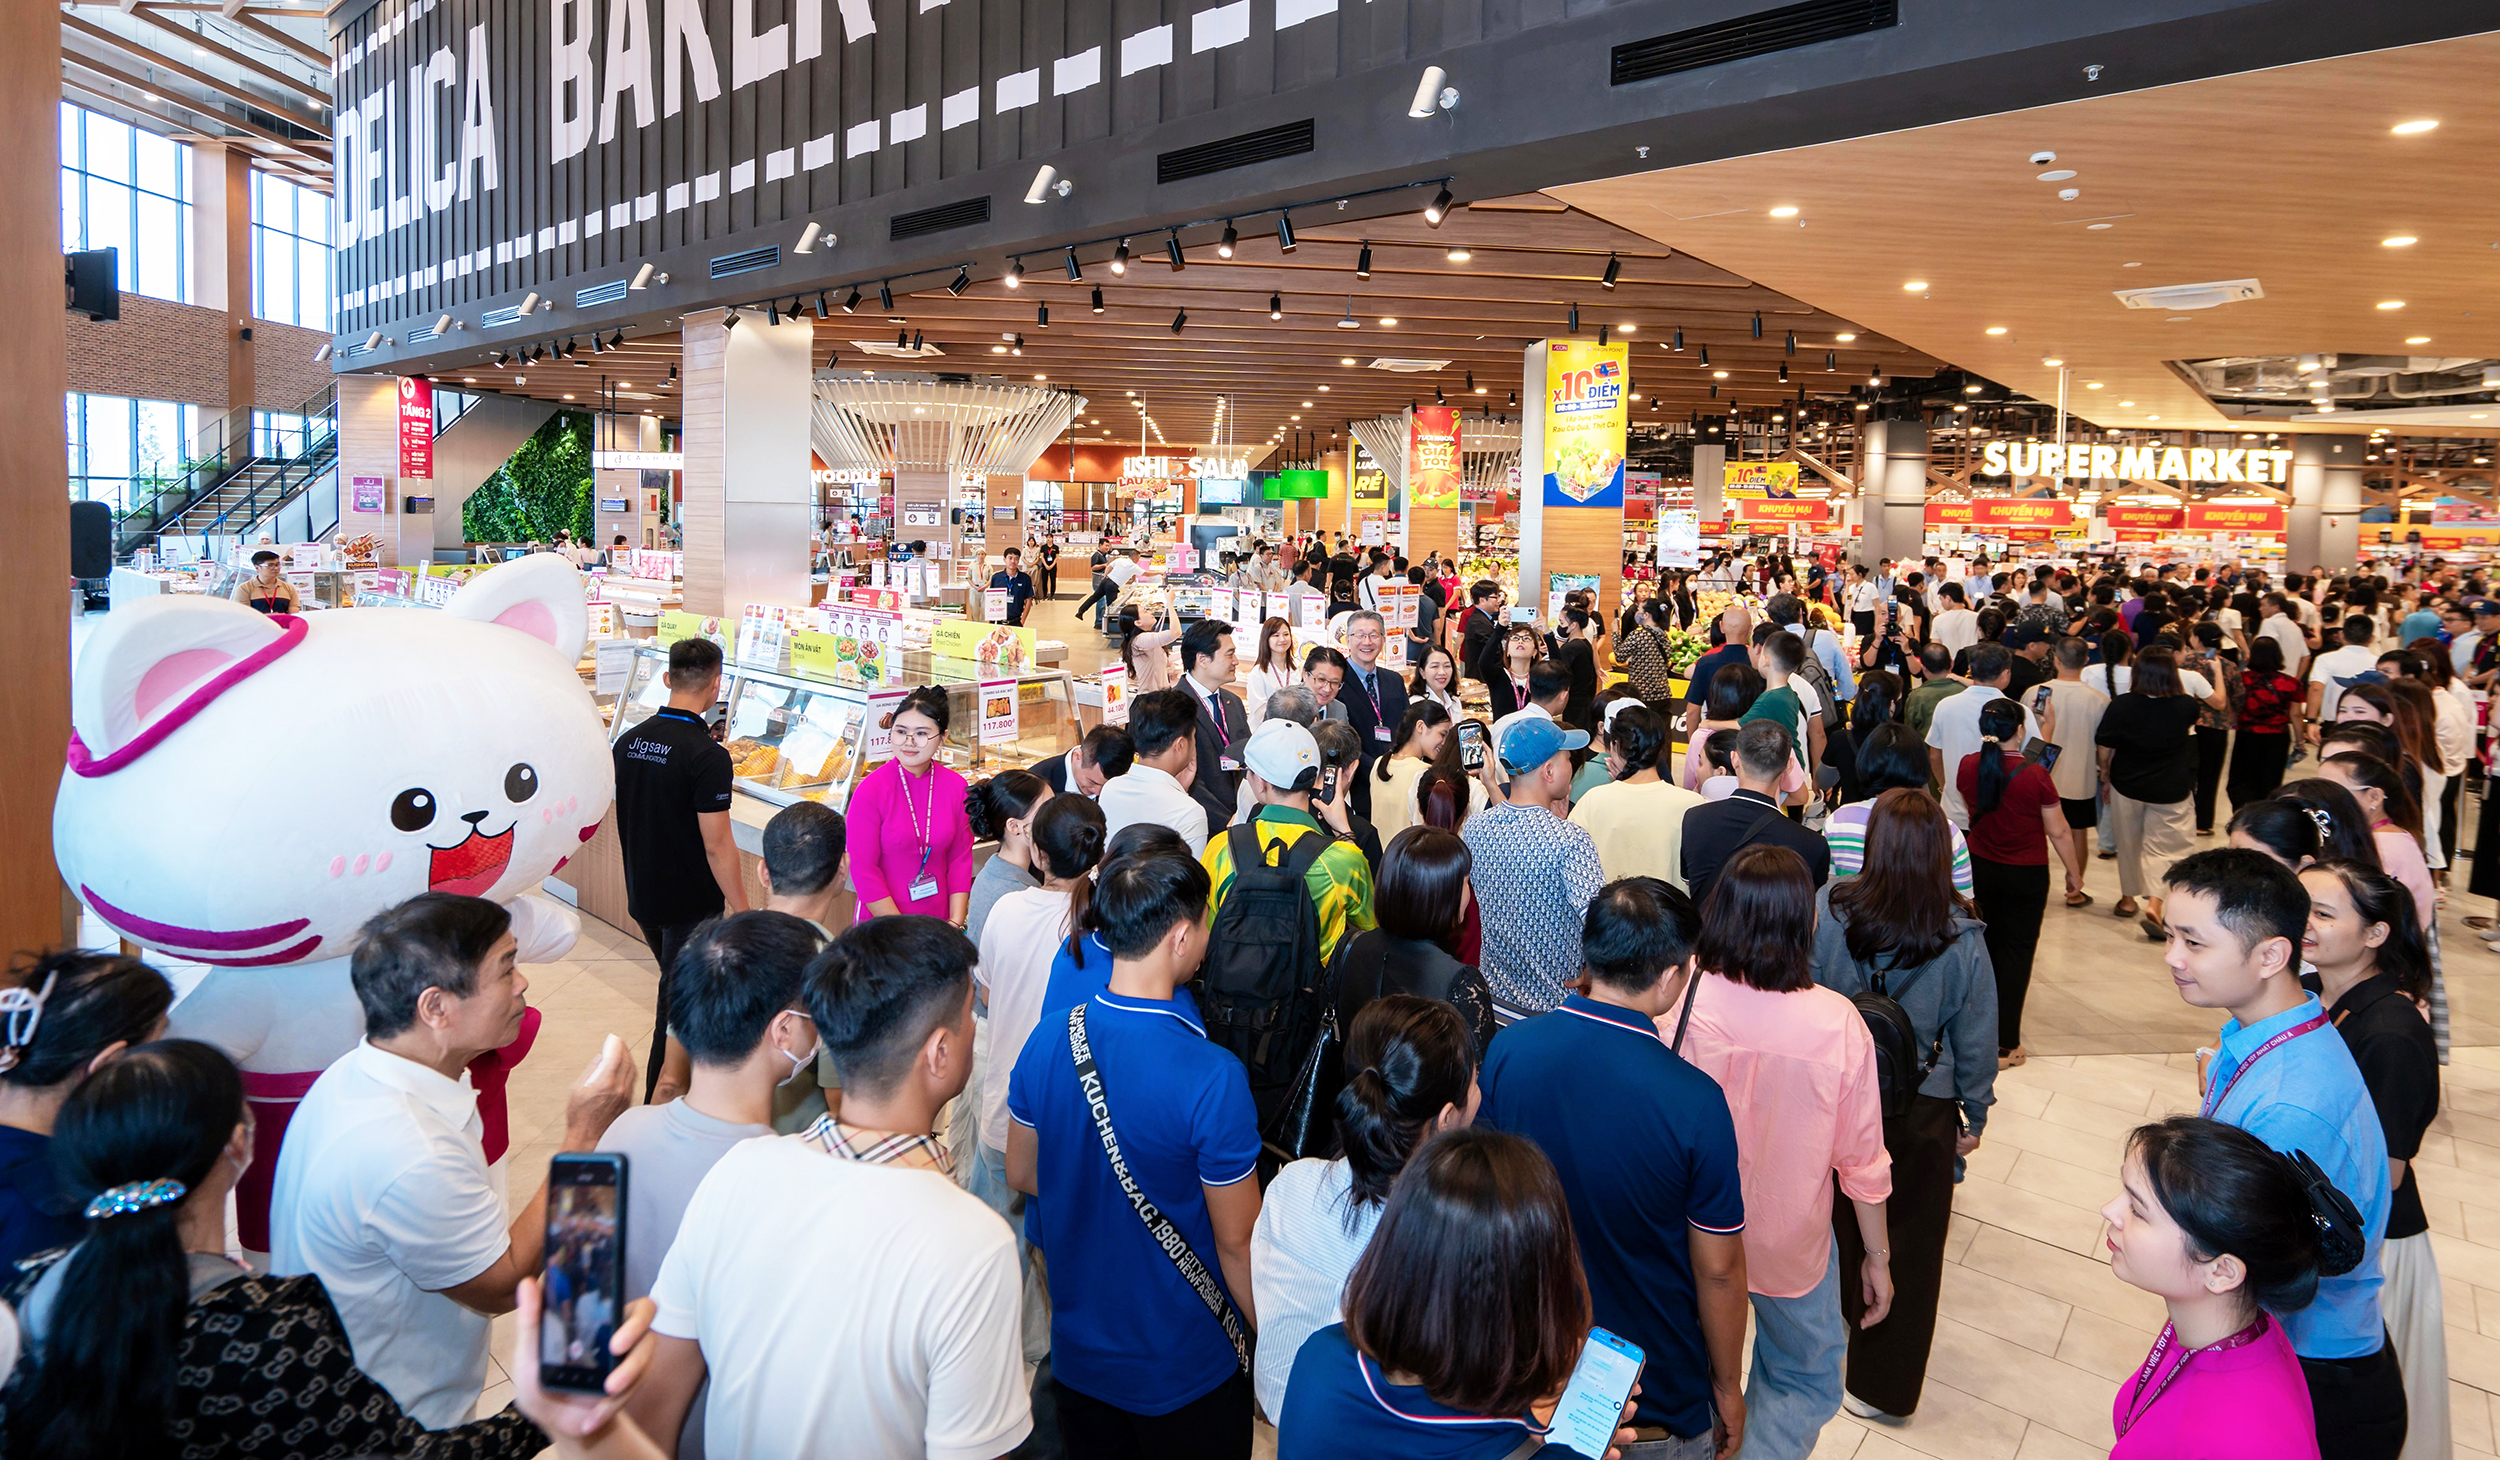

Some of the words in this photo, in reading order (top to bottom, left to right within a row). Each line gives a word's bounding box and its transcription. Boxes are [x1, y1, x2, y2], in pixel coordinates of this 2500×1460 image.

[335, 20, 498, 253] DELICA
[426, 408, 431, 419] 2
[1188, 456, 1248, 480] SALAD
[1982, 441, 2294, 483] SUPERMARKET
[1355, 470, 1384, 491] RẺ
[1758, 503, 1795, 513] KHUYẾN
[1795, 505, 1813, 516] MẠI
[1941, 507, 1973, 518] KHUYẾ
[1990, 503, 2034, 516] KHUYẾN
[2034, 507, 2055, 519] MẠI
[2121, 511, 2156, 522] KHUYẾN
[2157, 512, 2173, 523] MẠI
[2204, 509, 2247, 521] KHUYẾN
[2247, 511, 2268, 525] MẠI
[945, 630, 960, 639] CHIÊN
[628, 737, 672, 756] Jigsaw
[2148, 1351, 2162, 1370] VIỆC
[2166, 1363, 2181, 1381] WORK
[2179, 1353, 2190, 1366] FOR
